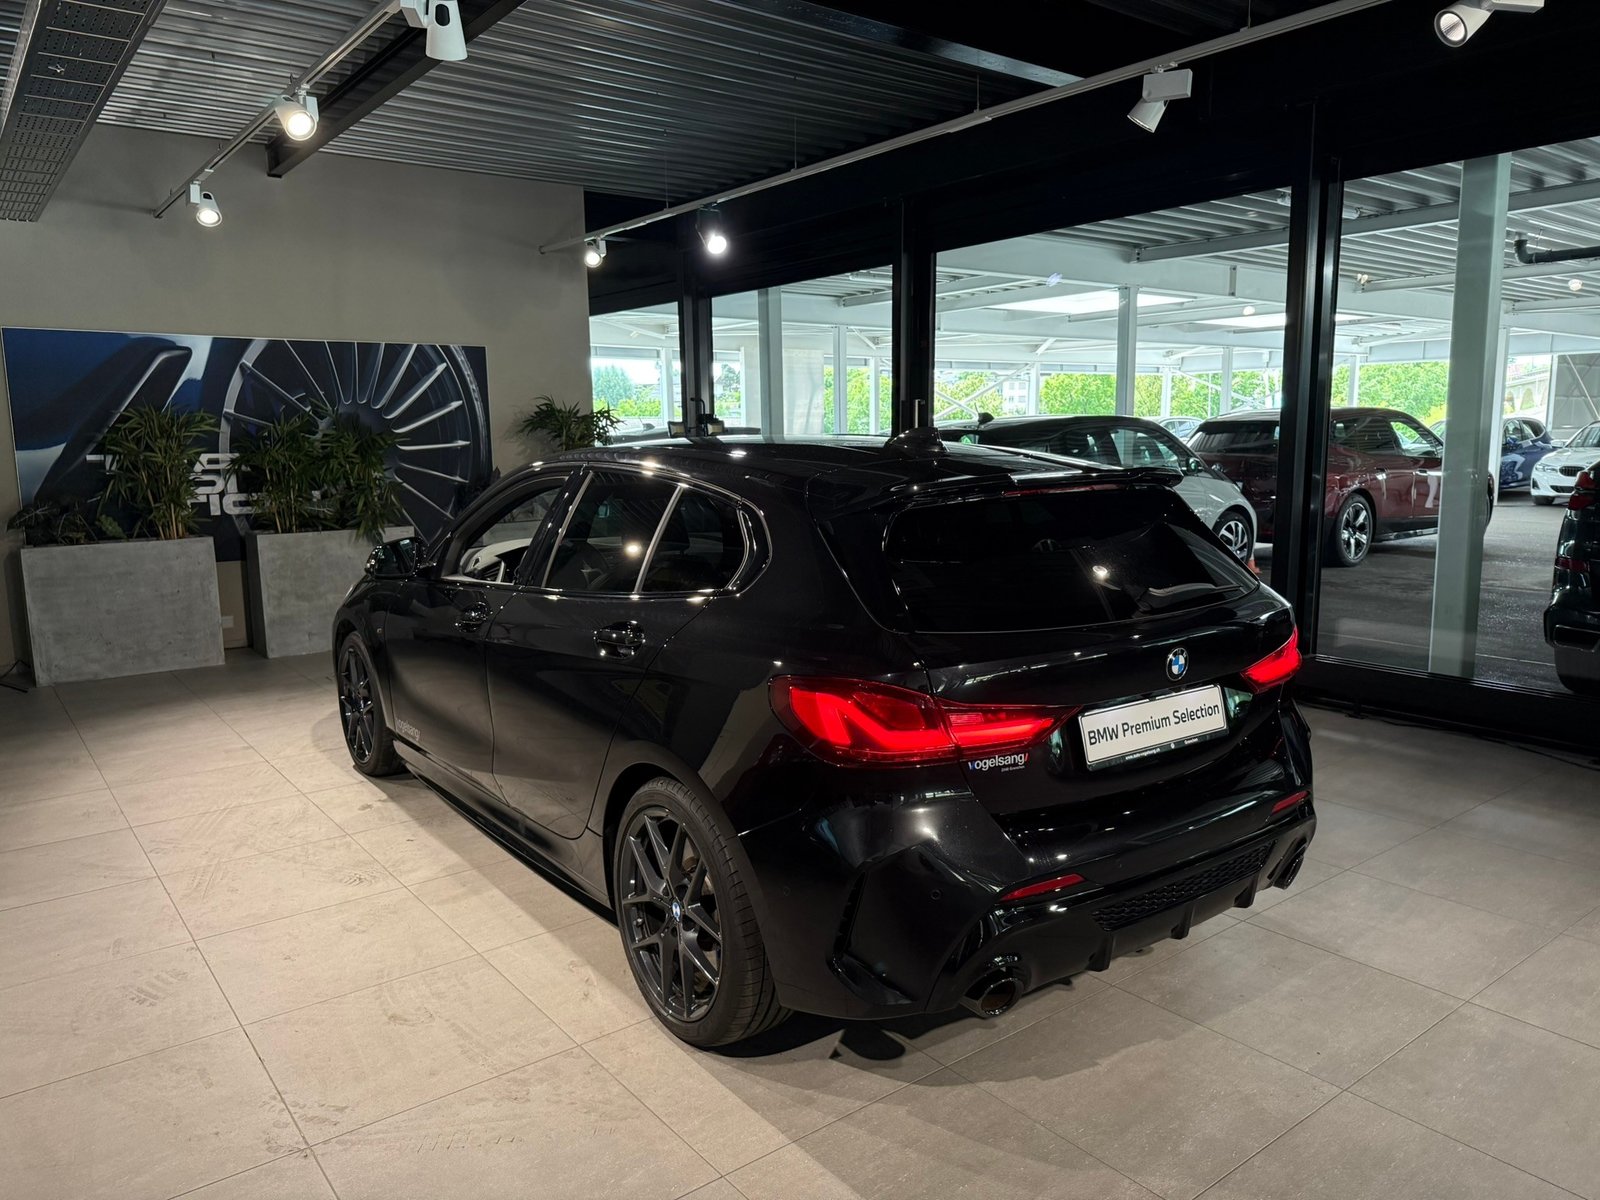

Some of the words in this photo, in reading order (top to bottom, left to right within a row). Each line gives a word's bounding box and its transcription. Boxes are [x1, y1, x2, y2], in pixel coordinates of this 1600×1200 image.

[1088, 724, 1119, 746] BMW
[1121, 716, 1171, 737] Premium
[1172, 703, 1220, 725] Selection
